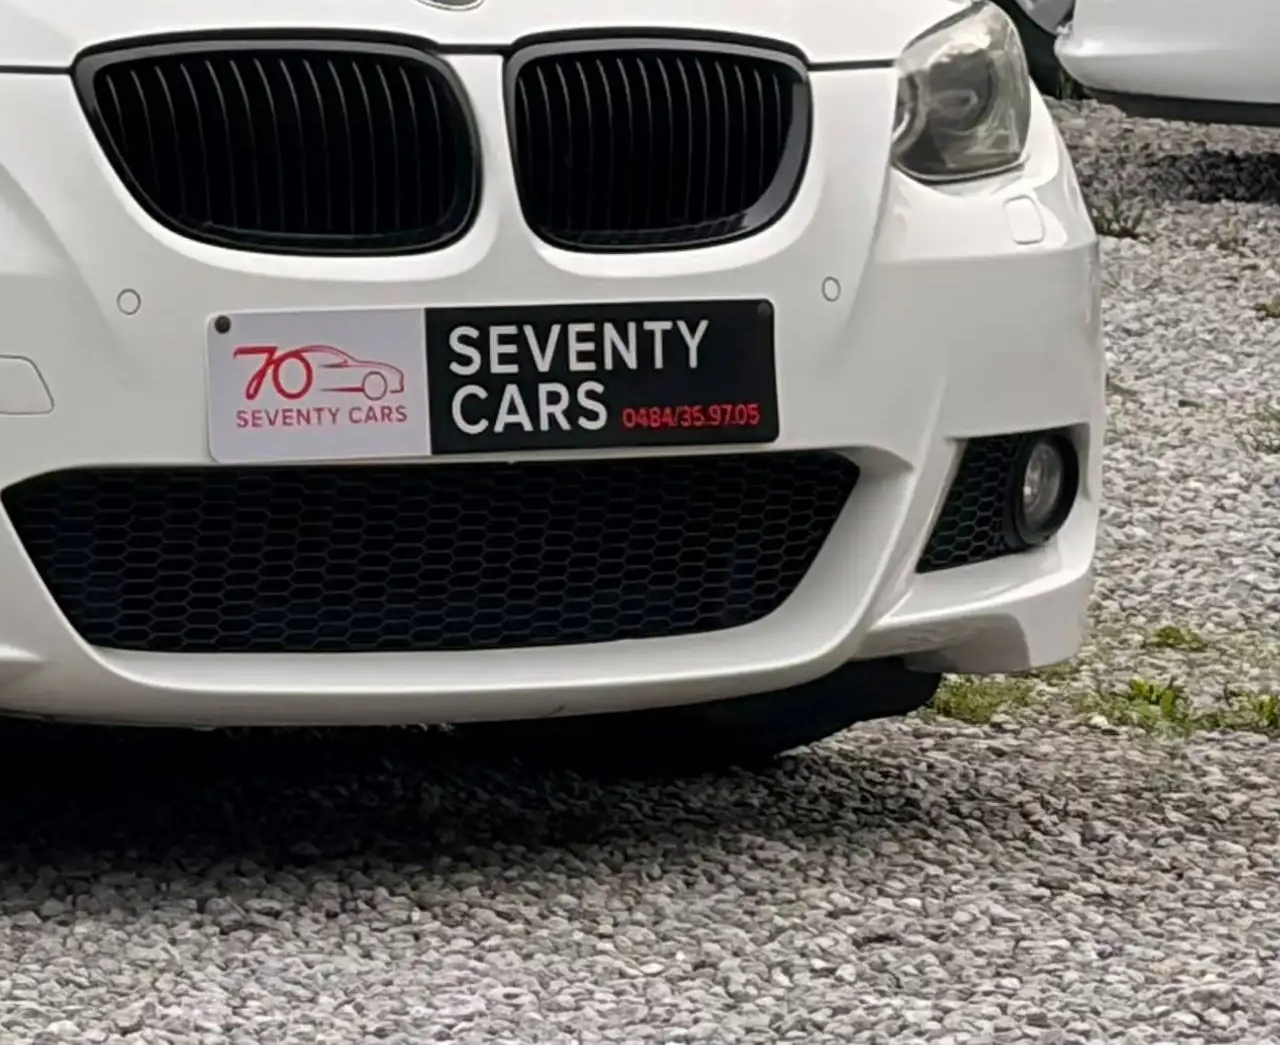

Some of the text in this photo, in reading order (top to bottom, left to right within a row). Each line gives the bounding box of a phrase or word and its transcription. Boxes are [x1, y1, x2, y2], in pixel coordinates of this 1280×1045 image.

[233, 345, 313, 400] 70
[448, 319, 709, 376] SEVENTY
[236, 405, 408, 428] SEVENTY CARS
[450, 380, 608, 435] CARS
[622, 403, 761, 429] 0484/35.97.05
